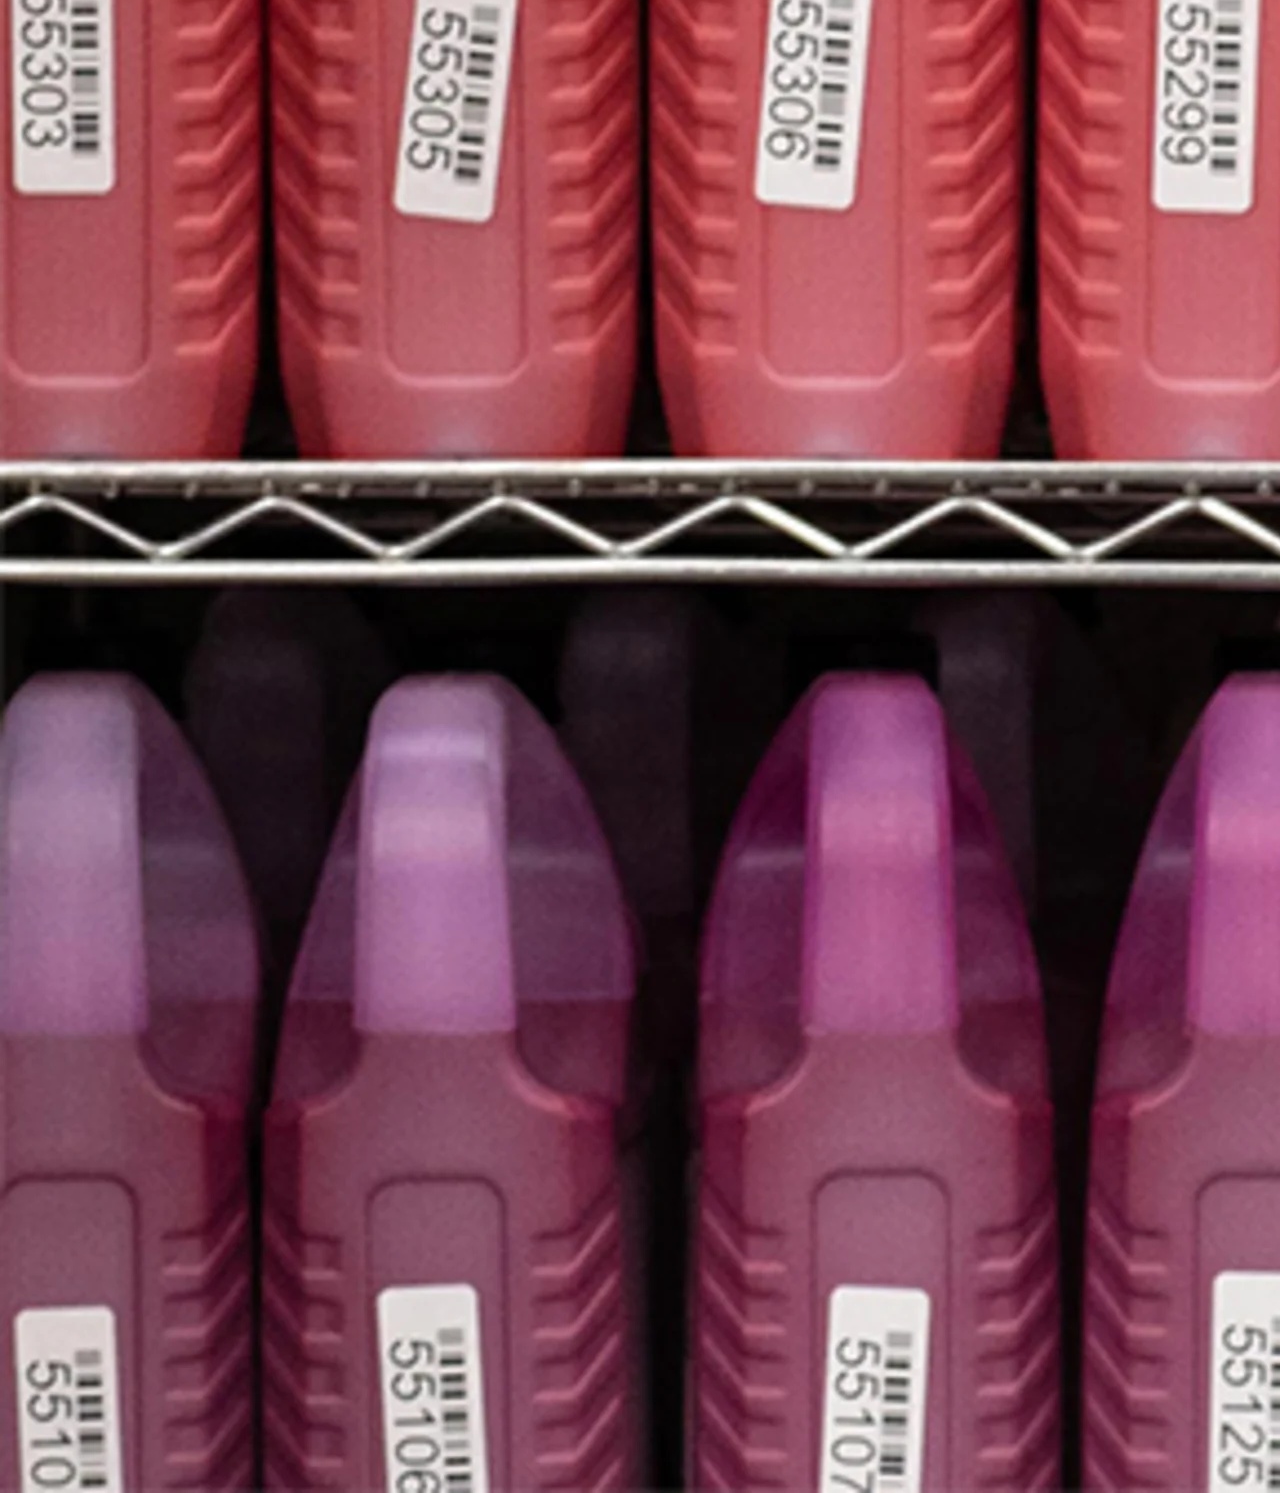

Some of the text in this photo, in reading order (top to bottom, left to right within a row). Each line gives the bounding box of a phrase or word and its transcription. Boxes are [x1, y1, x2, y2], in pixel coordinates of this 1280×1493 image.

[408, 7, 467, 171] 55305
[1160, 2, 1209, 165] 55299
[391, 1339, 441, 1493] 55106
[829, 1337, 879, 1493] 55107
[1218, 1323, 1266, 1487] 55125
